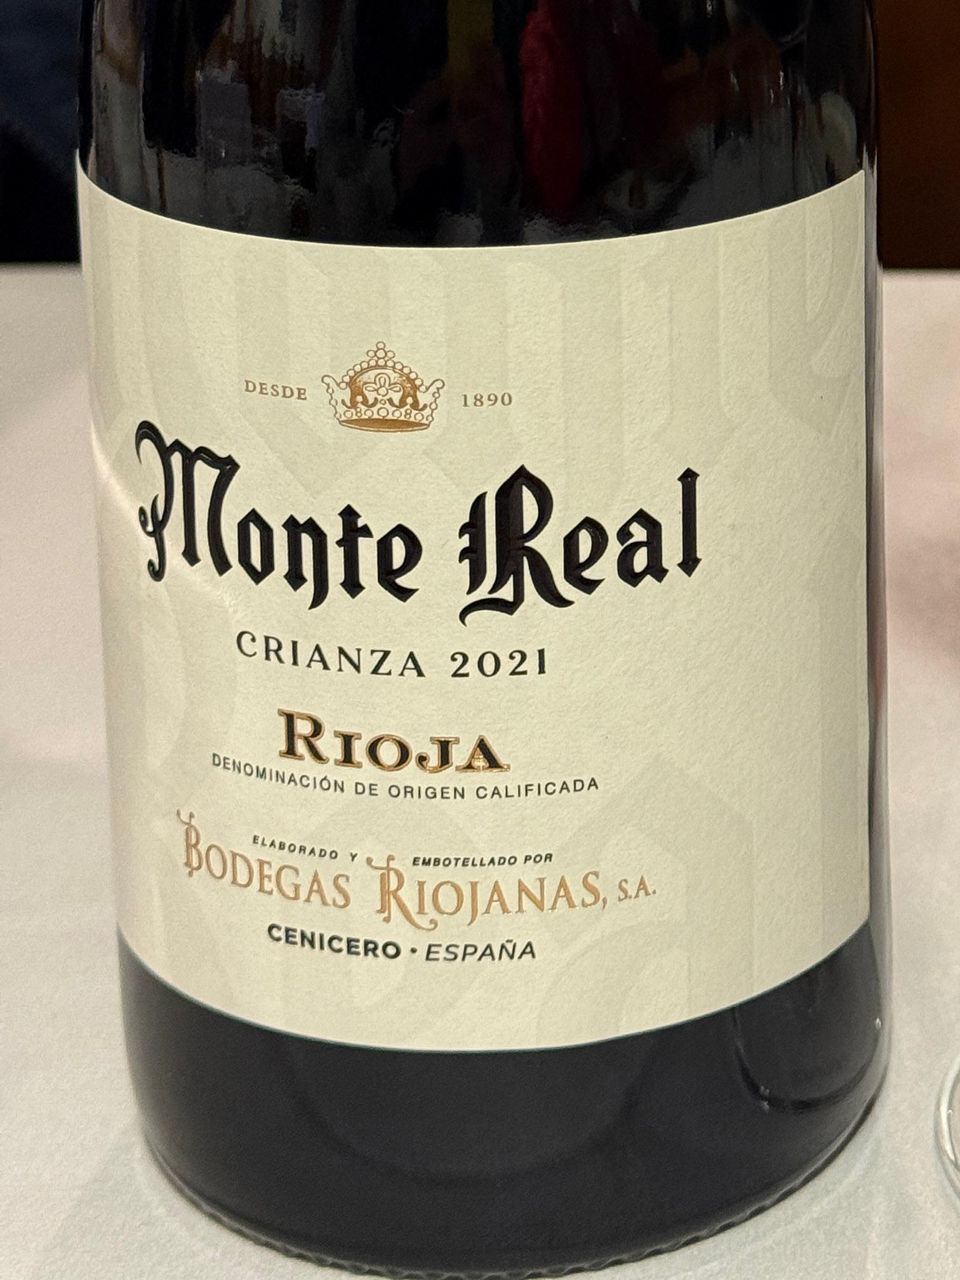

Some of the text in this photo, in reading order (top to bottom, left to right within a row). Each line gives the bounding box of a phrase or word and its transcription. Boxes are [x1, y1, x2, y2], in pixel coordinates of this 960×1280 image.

[244, 379, 513, 408] DESDE 1890
[135, 420, 702, 627] Monte Real
[234, 630, 548, 680] CRIANZA 2021
[277, 708, 511, 774] RIOJA
[211, 752, 600, 800] DENOMINACIÓN DE ORIGEN CALIFICADA
[176, 809, 352, 910] BODEGAS
[616, 874, 658, 903] S.A.
[252, 834, 554, 869] ELABORADO Y EMBOTELLADO POR
[267, 922, 538, 963] CENICERO ESPAÑA
